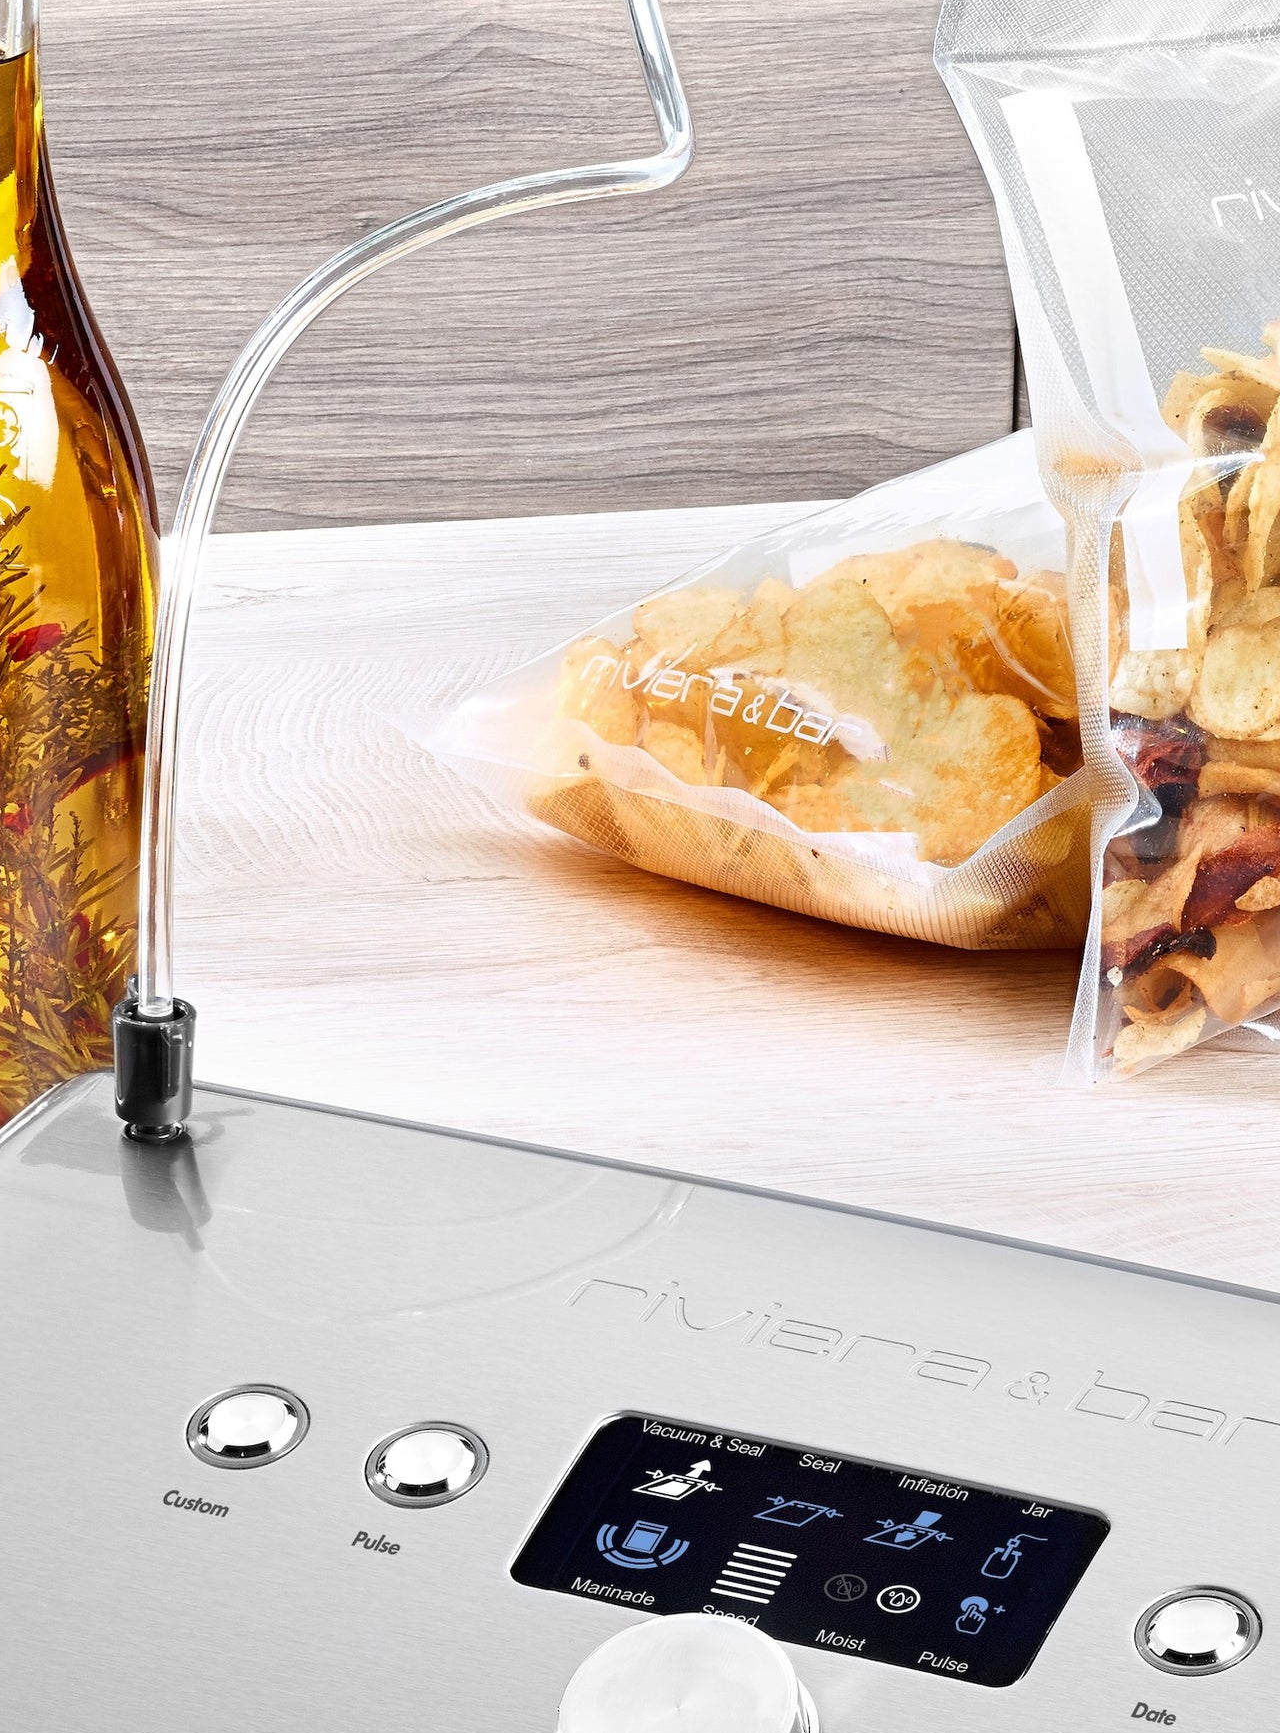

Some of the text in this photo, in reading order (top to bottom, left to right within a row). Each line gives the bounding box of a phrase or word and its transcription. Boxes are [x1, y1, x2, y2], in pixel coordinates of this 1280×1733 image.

[742, 693, 766, 725] &
[765, 690, 863, 747] bar
[562, 1278, 993, 1393] riviera
[1001, 1370, 1052, 1406] &
[641, 1418, 767, 1459] Vacuum & Seal
[798, 1452, 842, 1475] Seal
[897, 1473, 970, 1502] Inflation
[162, 1489, 230, 1518] Custom
[1021, 1501, 1054, 1521] Jar
[350, 1530, 401, 1556] Pulse
[570, 1576, 656, 1607] Marinade
[814, 1628, 867, 1652] Moist
[916, 1650, 970, 1674] Pulse
[1130, 1701, 1177, 1727] Date
